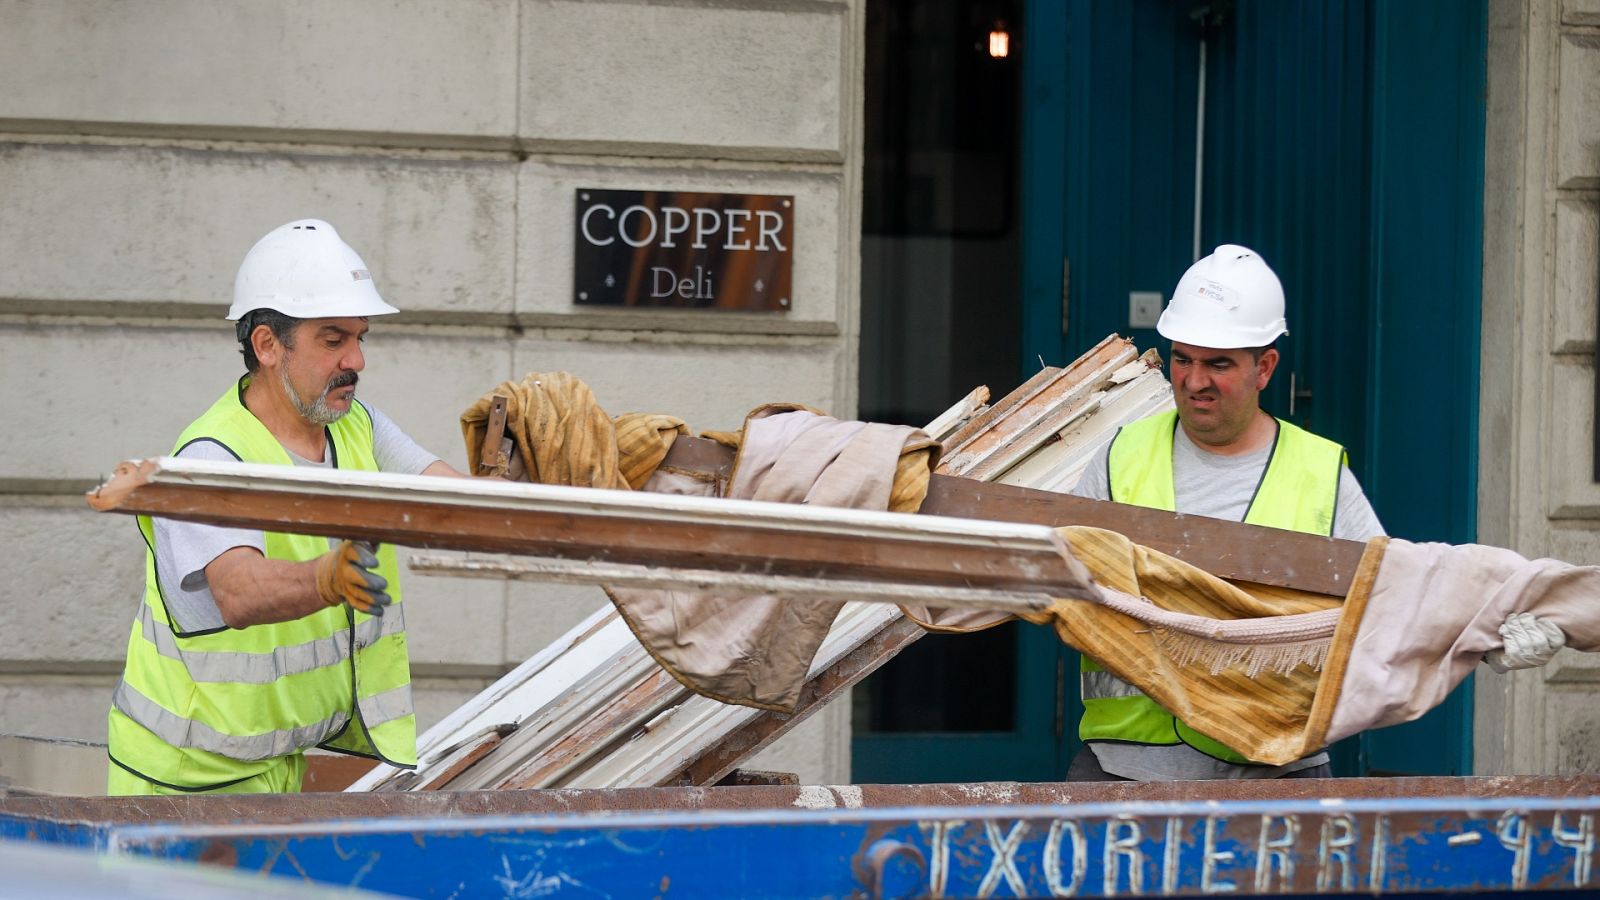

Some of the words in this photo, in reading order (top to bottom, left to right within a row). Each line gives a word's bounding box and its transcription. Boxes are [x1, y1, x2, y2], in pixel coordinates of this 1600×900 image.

[581, 204, 787, 251] COPPER
[651, 266, 714, 299] Deli
[918, 814, 1387, 897] TXORIERRI
